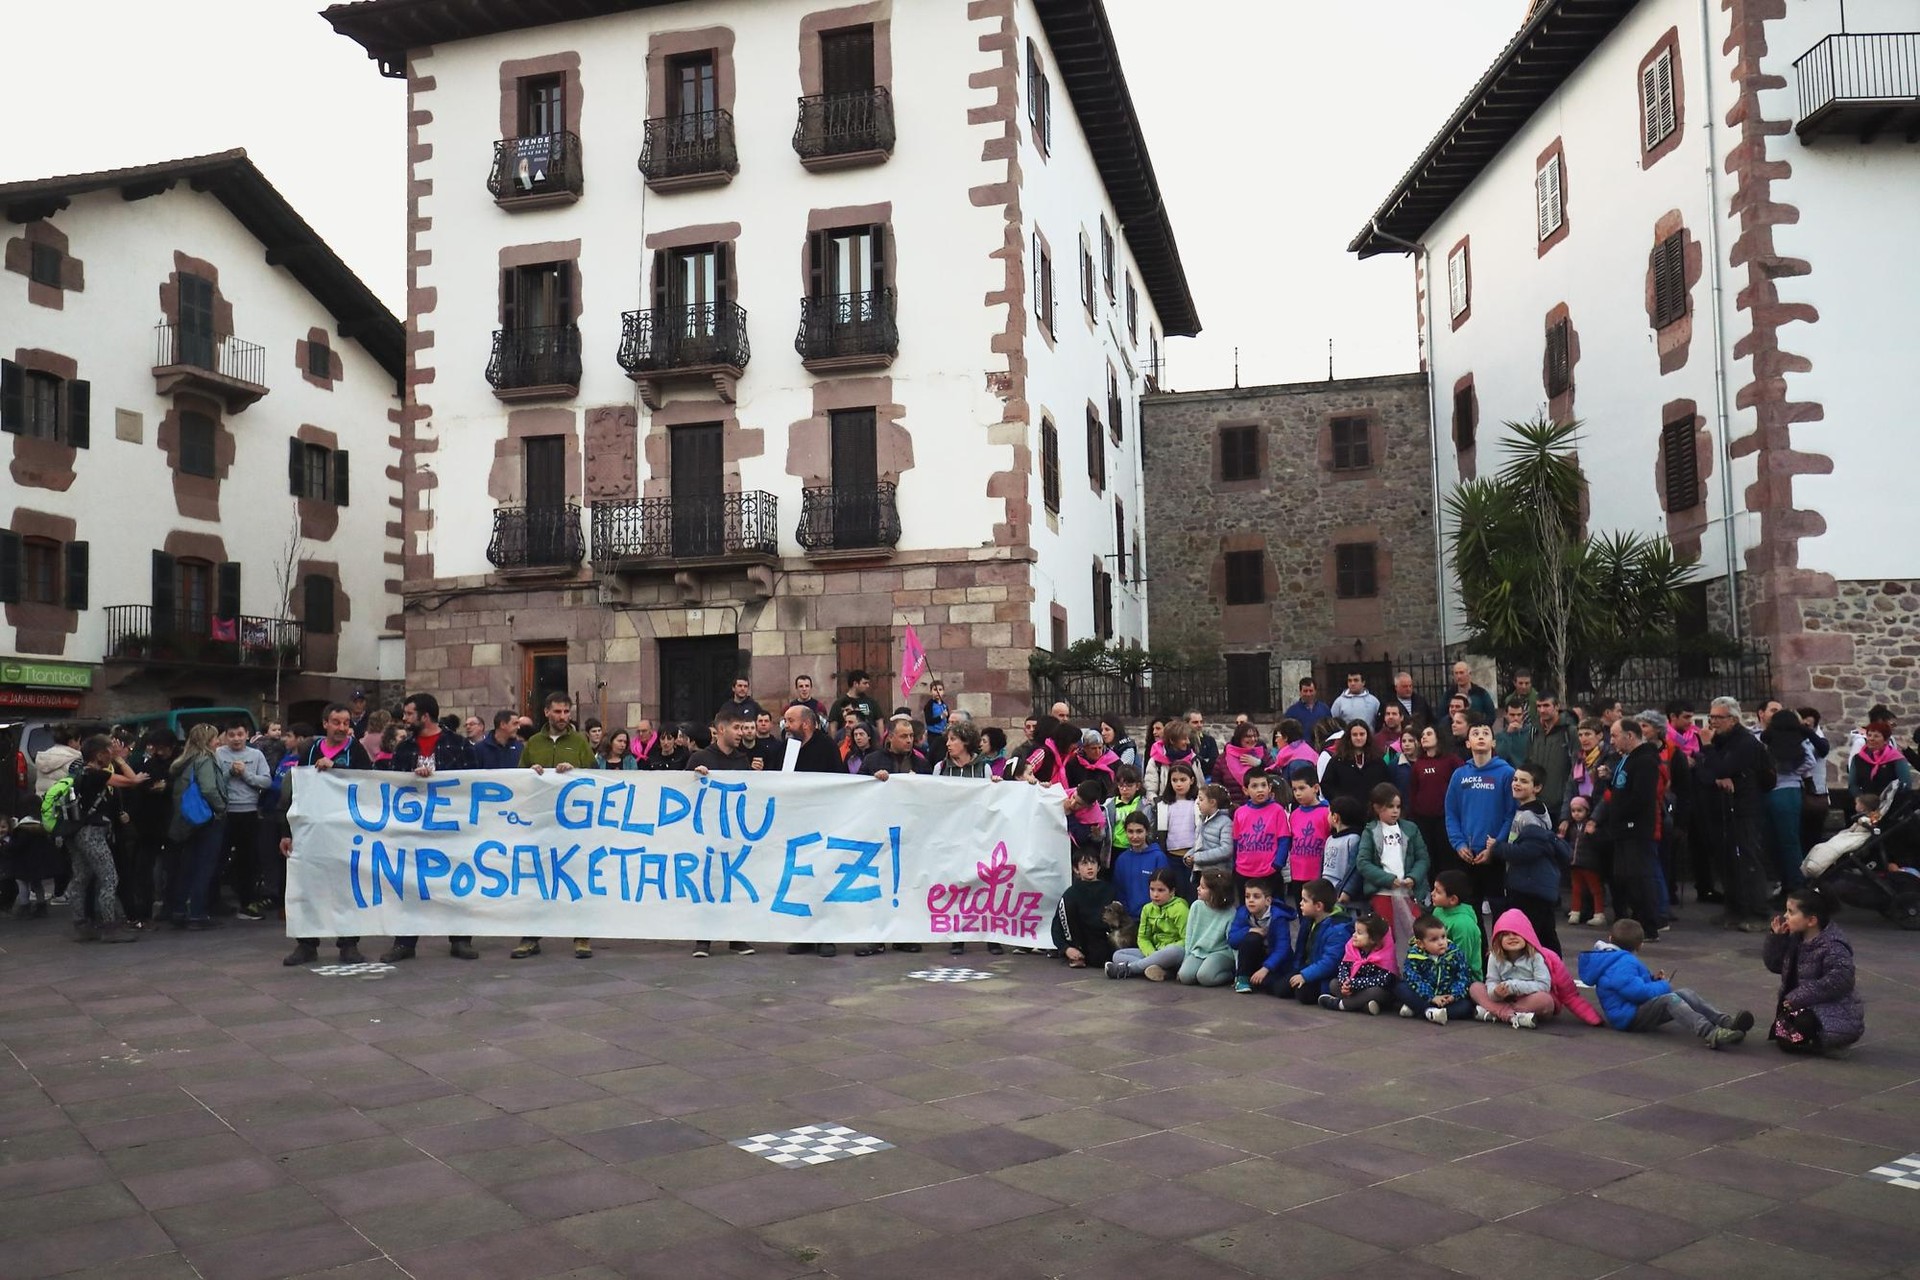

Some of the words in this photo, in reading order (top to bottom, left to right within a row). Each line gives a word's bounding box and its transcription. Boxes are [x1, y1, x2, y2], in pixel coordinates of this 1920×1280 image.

[518, 136, 550, 146] VENDE
[37, 695, 61, 705] DENDA
[926, 866, 1044, 921] erdiz
[930, 914, 1038, 940] BIZIRIK
